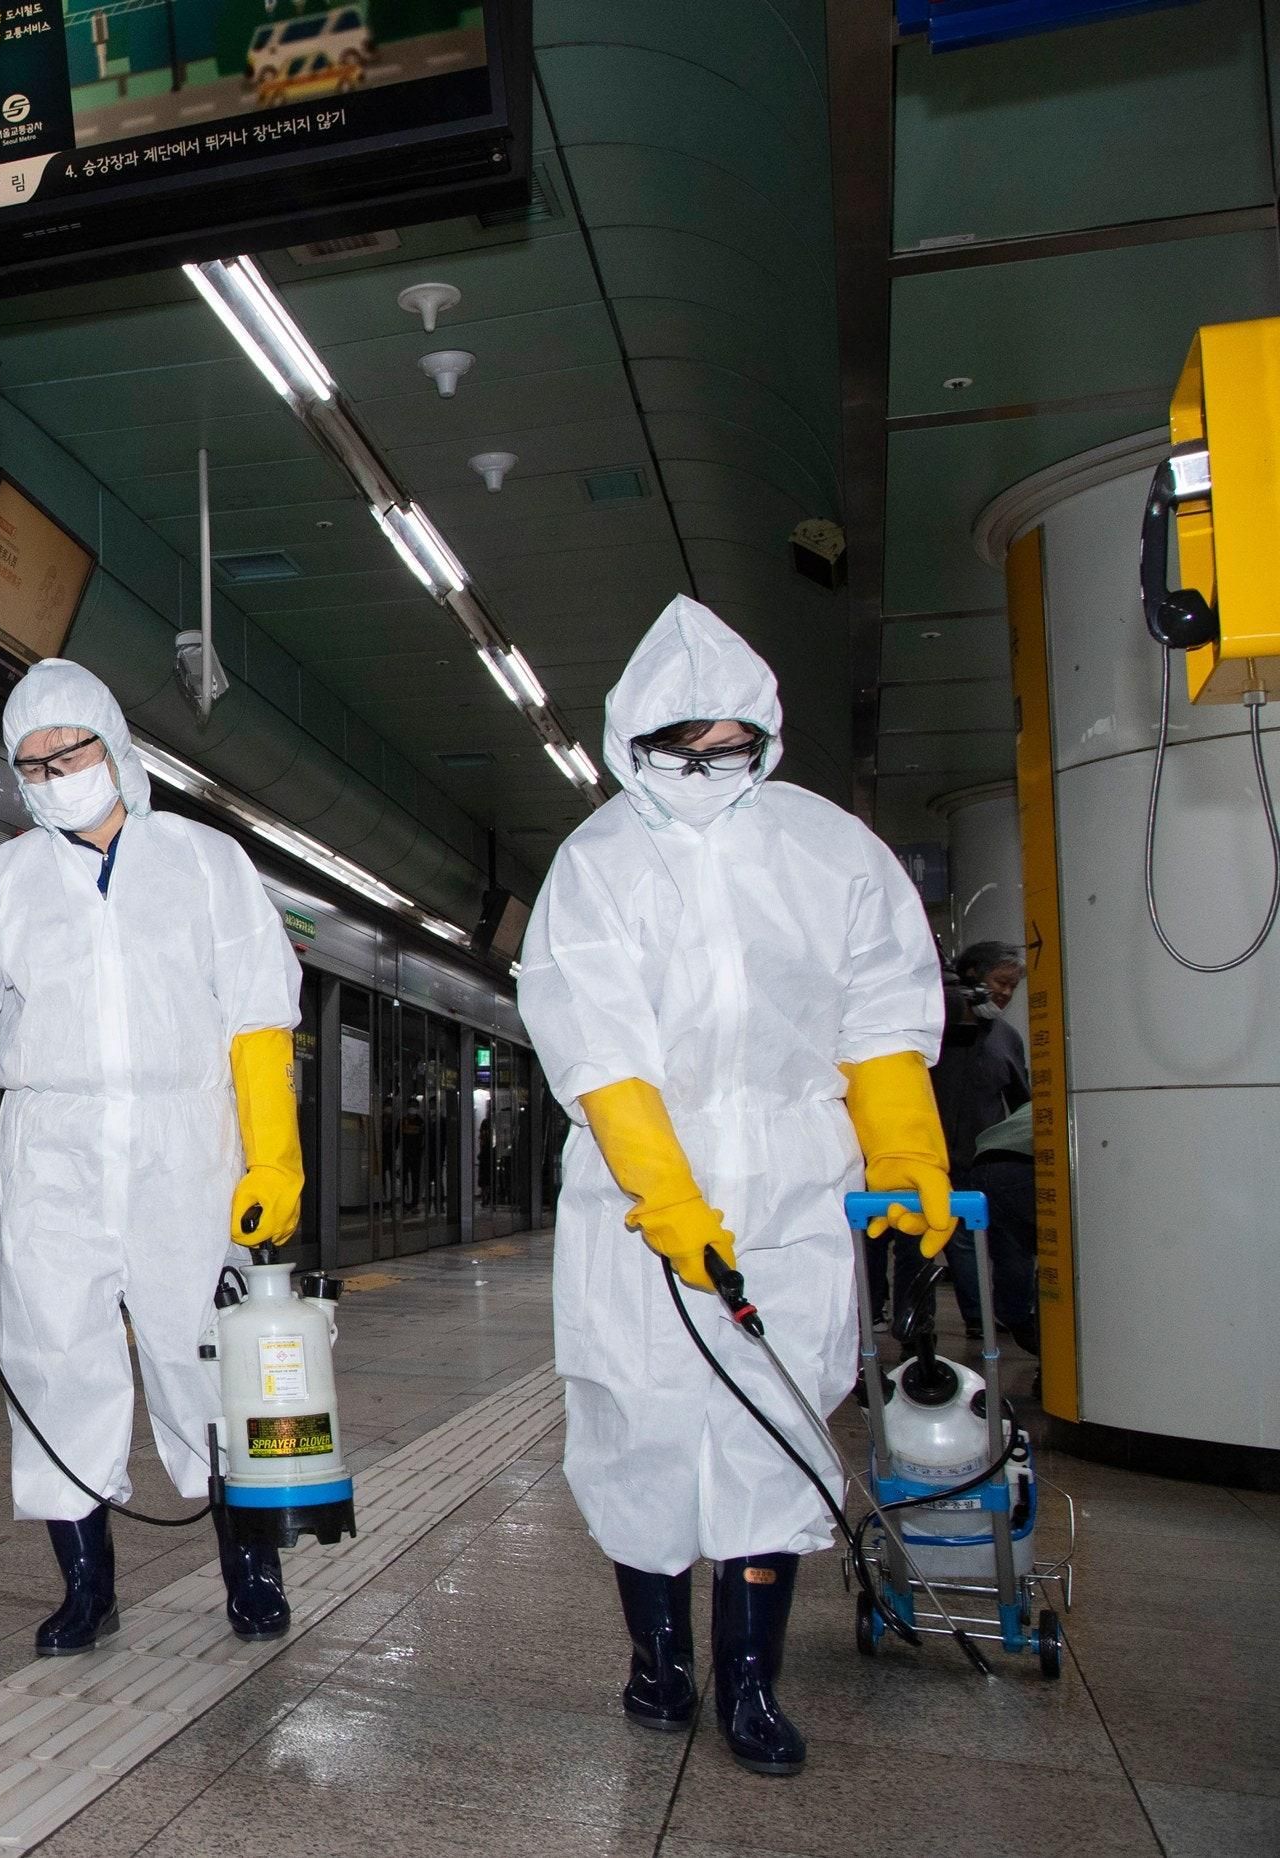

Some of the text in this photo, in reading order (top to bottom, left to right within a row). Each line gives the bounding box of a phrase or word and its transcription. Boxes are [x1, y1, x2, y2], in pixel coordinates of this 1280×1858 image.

[5, 3, 43, 20] 도시철도
[4, 21, 52, 40] 교통서비스
[2, 134, 37, 147] Seoul Metro
[65, 108, 346, 178] 4. 승강장과 계단에서 뛰거나 장난치지 않기
[252, 1434, 331, 1449] SPRAYER CLOVER
